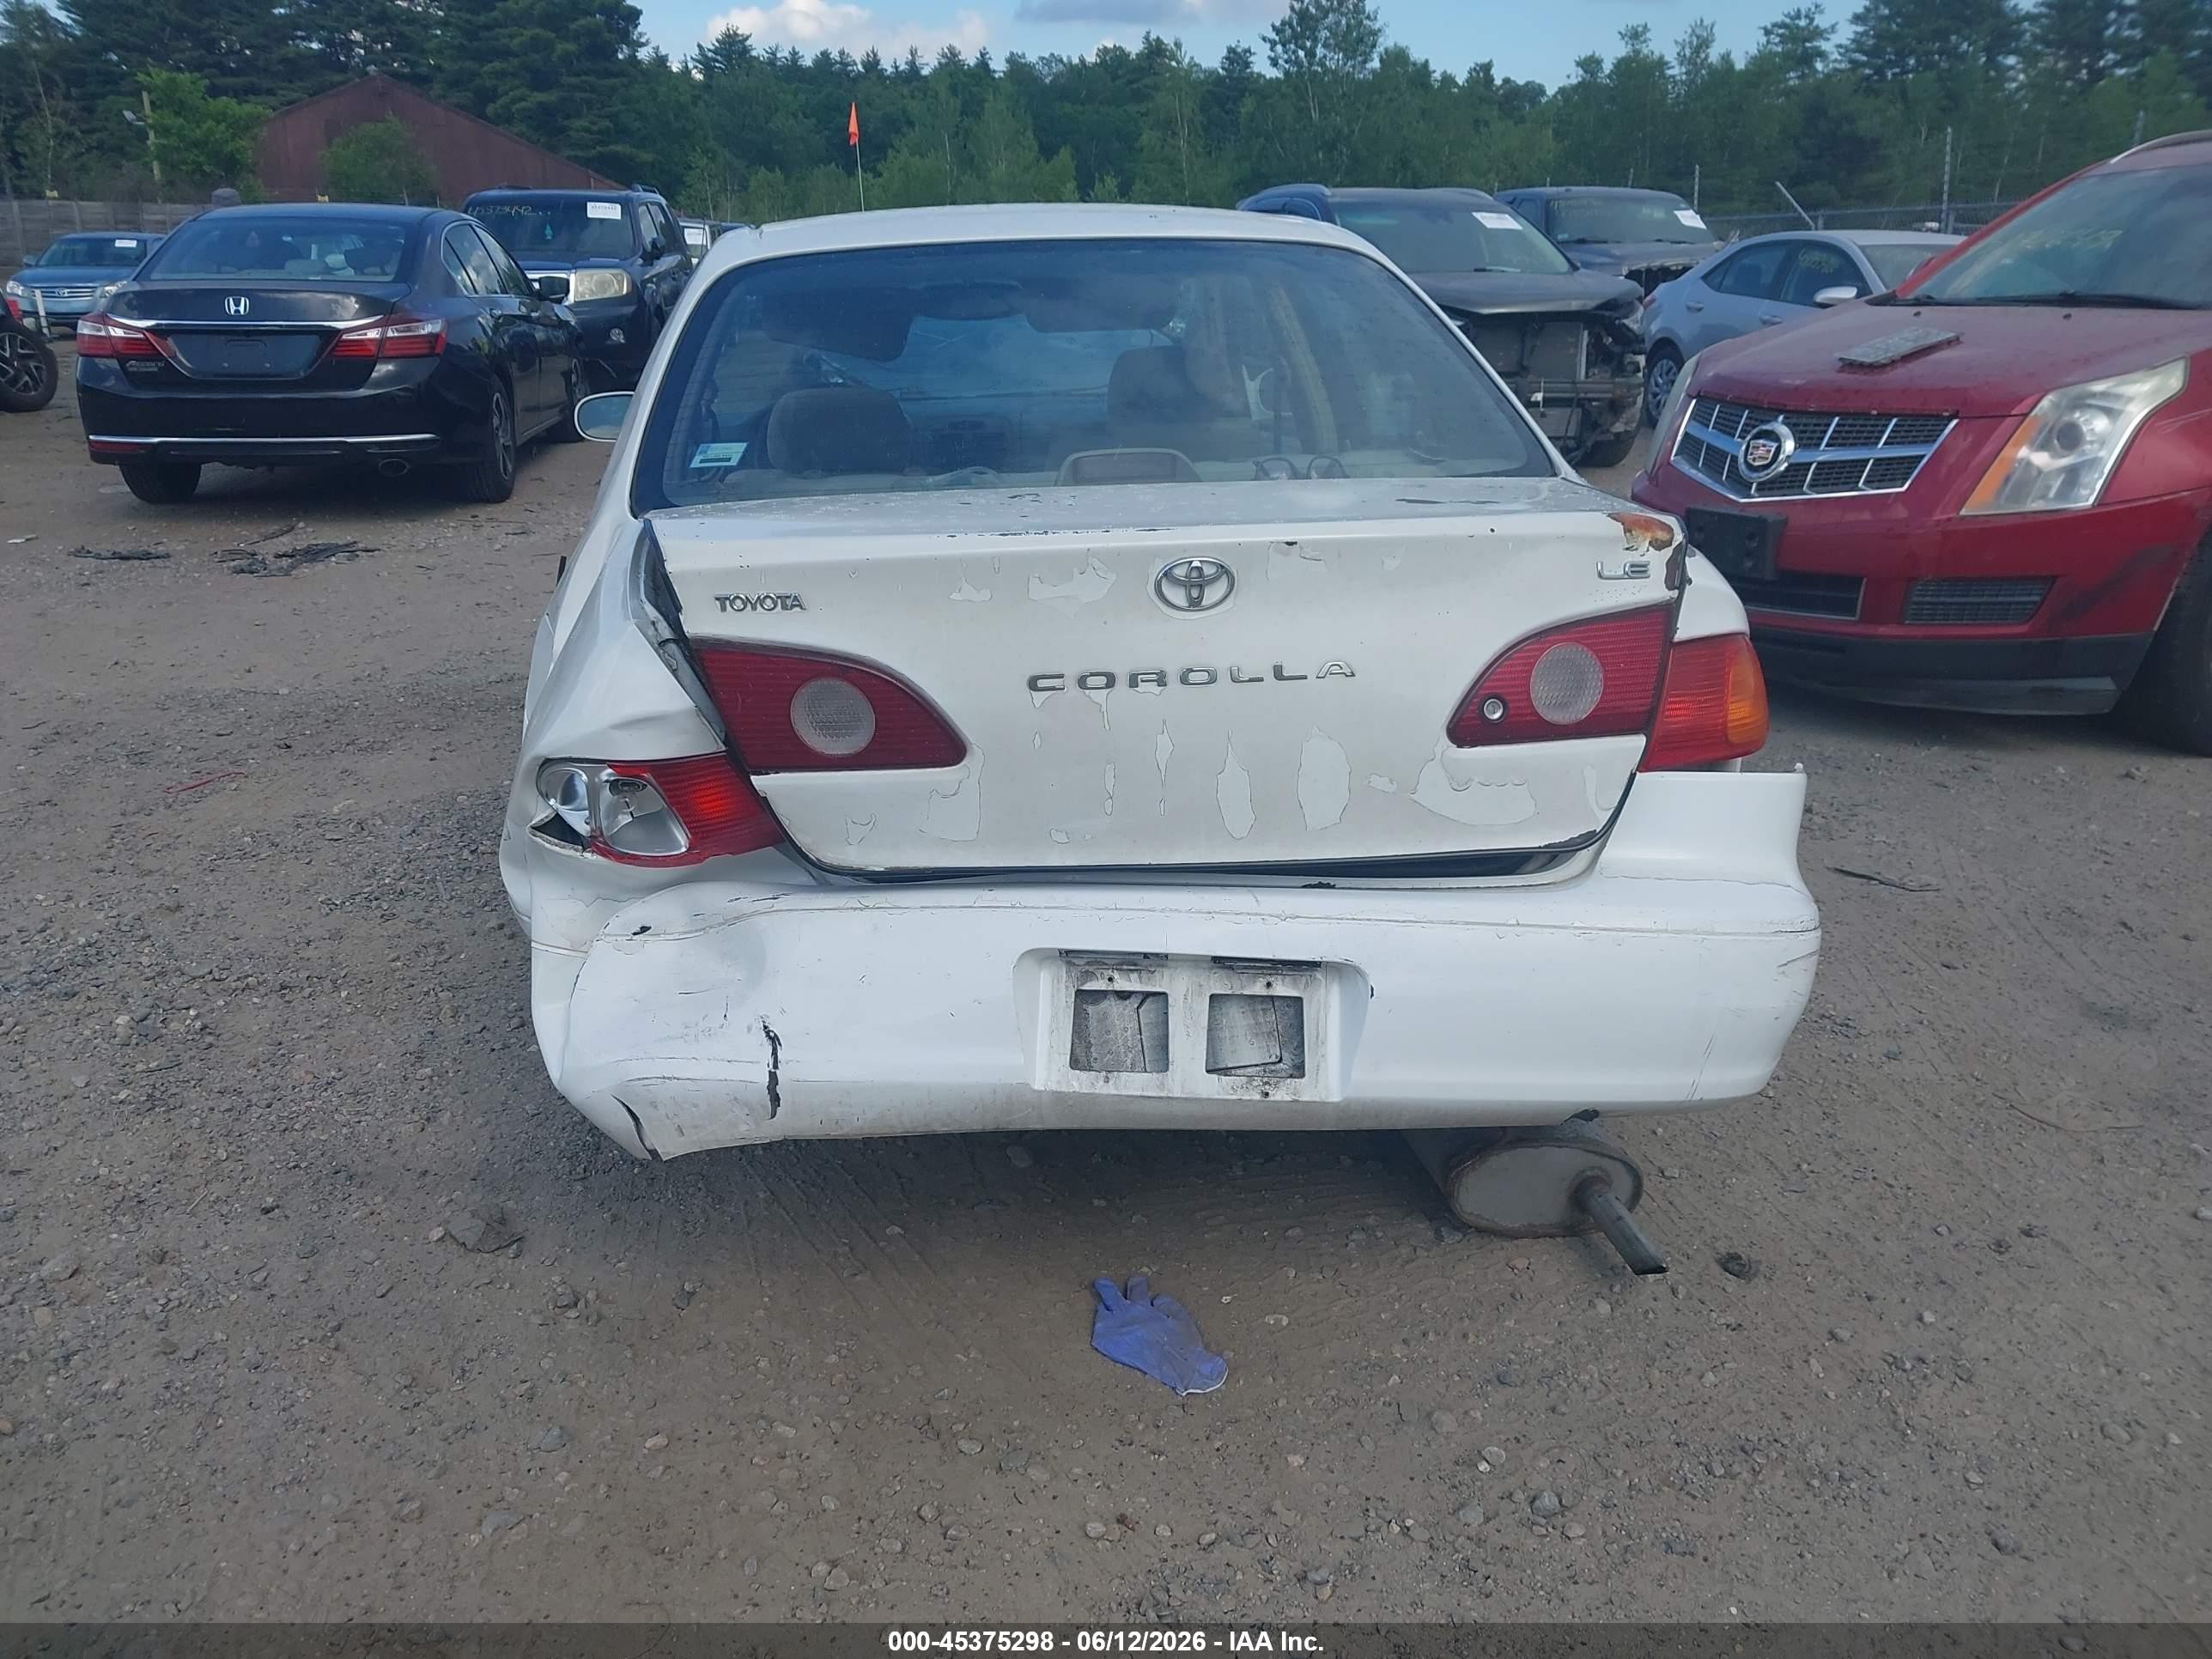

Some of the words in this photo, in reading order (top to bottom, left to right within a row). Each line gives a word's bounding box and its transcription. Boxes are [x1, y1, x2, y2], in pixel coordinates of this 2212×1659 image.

[1596, 561, 1650, 580] LE
[714, 592, 807, 613] TOYOTA
[1027, 660, 1356, 692] COROLLA
